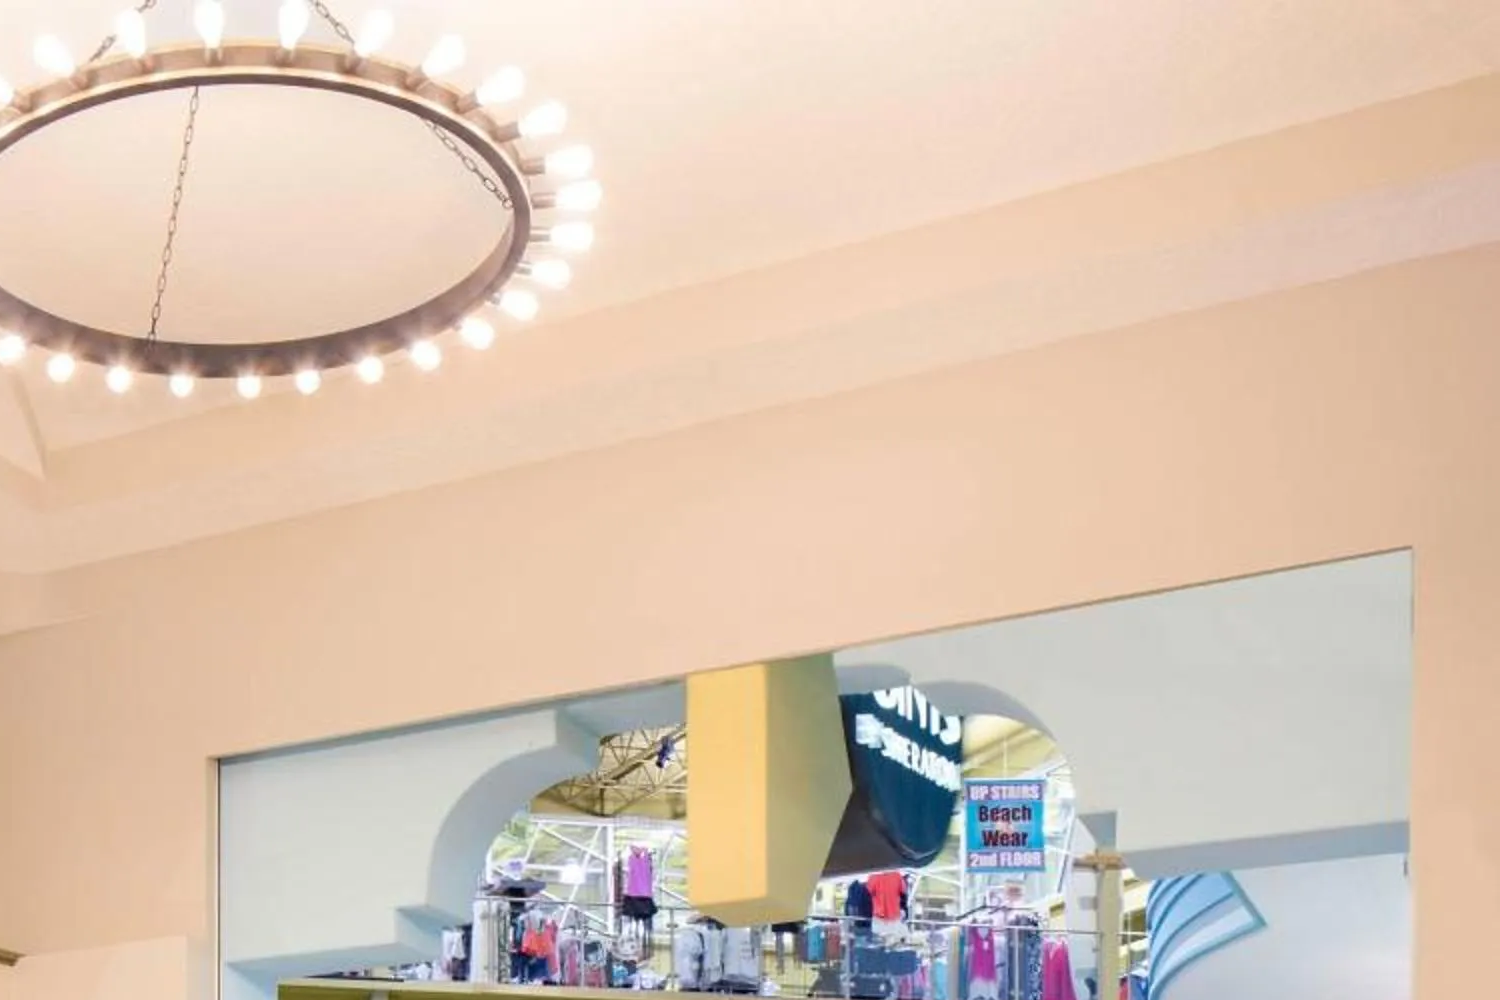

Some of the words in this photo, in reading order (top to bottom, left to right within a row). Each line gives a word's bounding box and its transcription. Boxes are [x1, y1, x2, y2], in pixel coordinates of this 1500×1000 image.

[978, 805, 1033, 823] Beach
[982, 829, 1029, 847] Wear
[969, 852, 998, 868] 2nd
[999, 851, 1042, 867] FLOOR
